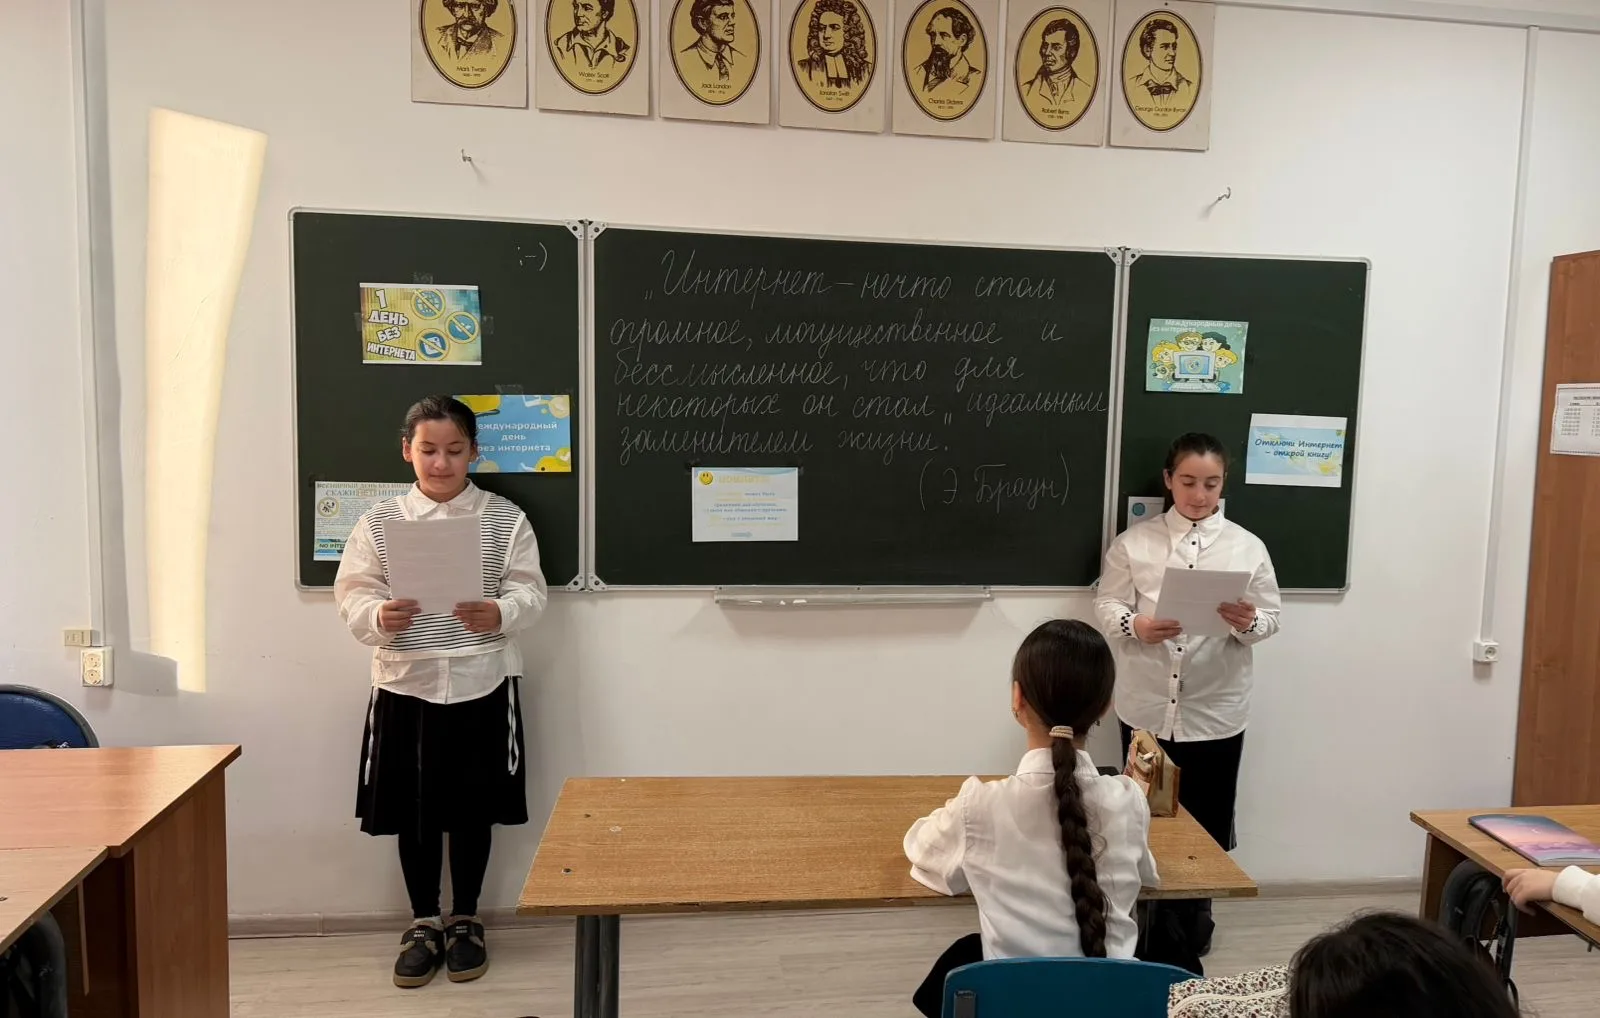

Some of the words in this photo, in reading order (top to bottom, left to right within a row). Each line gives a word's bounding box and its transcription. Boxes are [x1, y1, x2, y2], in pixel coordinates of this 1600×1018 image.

[861, 271, 952, 299] нечто
[975, 275, 1056, 300] столь
[375, 289, 387, 309] 1
[368, 310, 409, 326] ДЕНЬ
[376, 326, 401, 343] БЕЗ
[766, 307, 1003, 360] могущественное
[1041, 321, 1064, 342] и
[366, 341, 416, 361] ИНТЕРНЕТА
[860, 359, 927, 382] что
[954, 356, 1024, 392] для
[617, 393, 781, 433] некоторых
[803, 394, 839, 418] он
[852, 395, 936, 418] стал
[477, 421, 558, 431] еждународный
[501, 434, 527, 442] день
[620, 426, 814, 465] заменителем
[1254, 438, 1295, 447] Отключи
[1298, 440, 1343, 451] Интернет
[498, 444, 551, 453] интернета
[1273, 449, 1305, 460] открой
